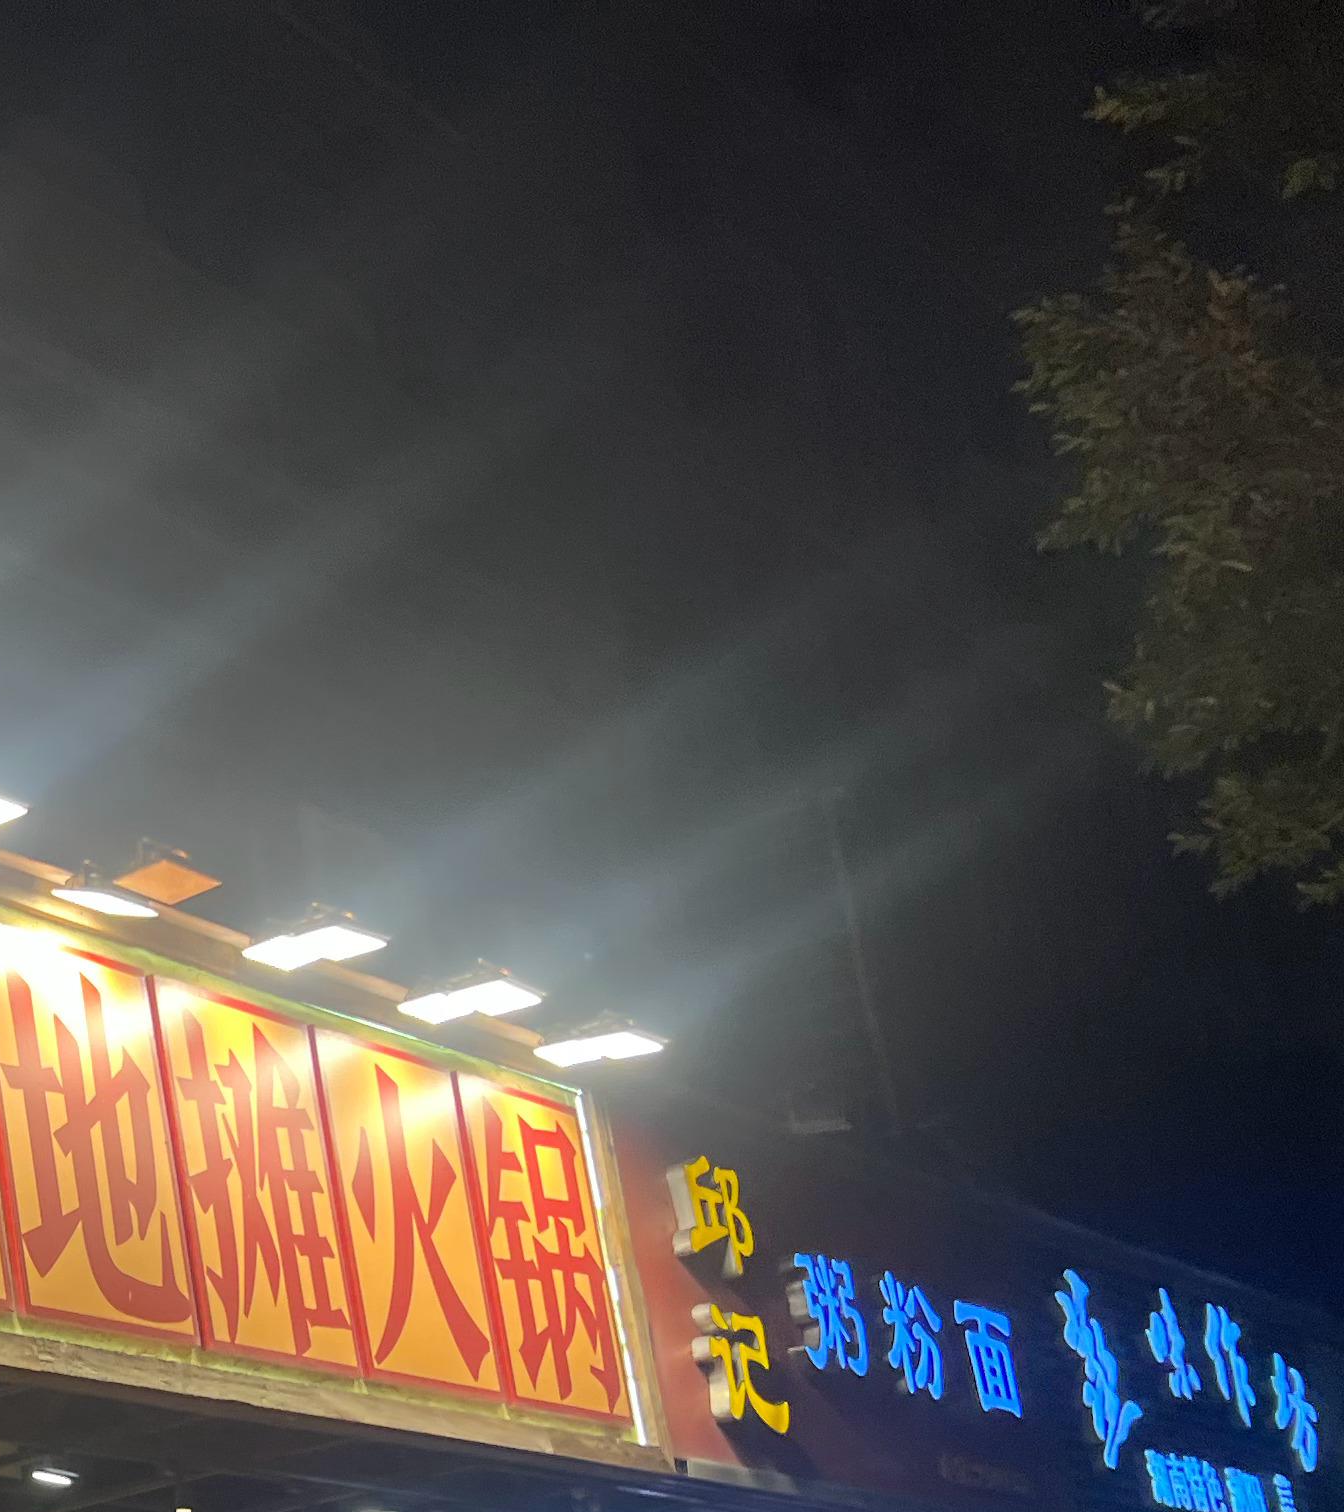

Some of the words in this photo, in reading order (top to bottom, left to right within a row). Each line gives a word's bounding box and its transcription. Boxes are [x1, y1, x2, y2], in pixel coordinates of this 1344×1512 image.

[689, 1155, 790, 1435] 邱记
[792, 1252, 1023, 1418] 粥粉面
